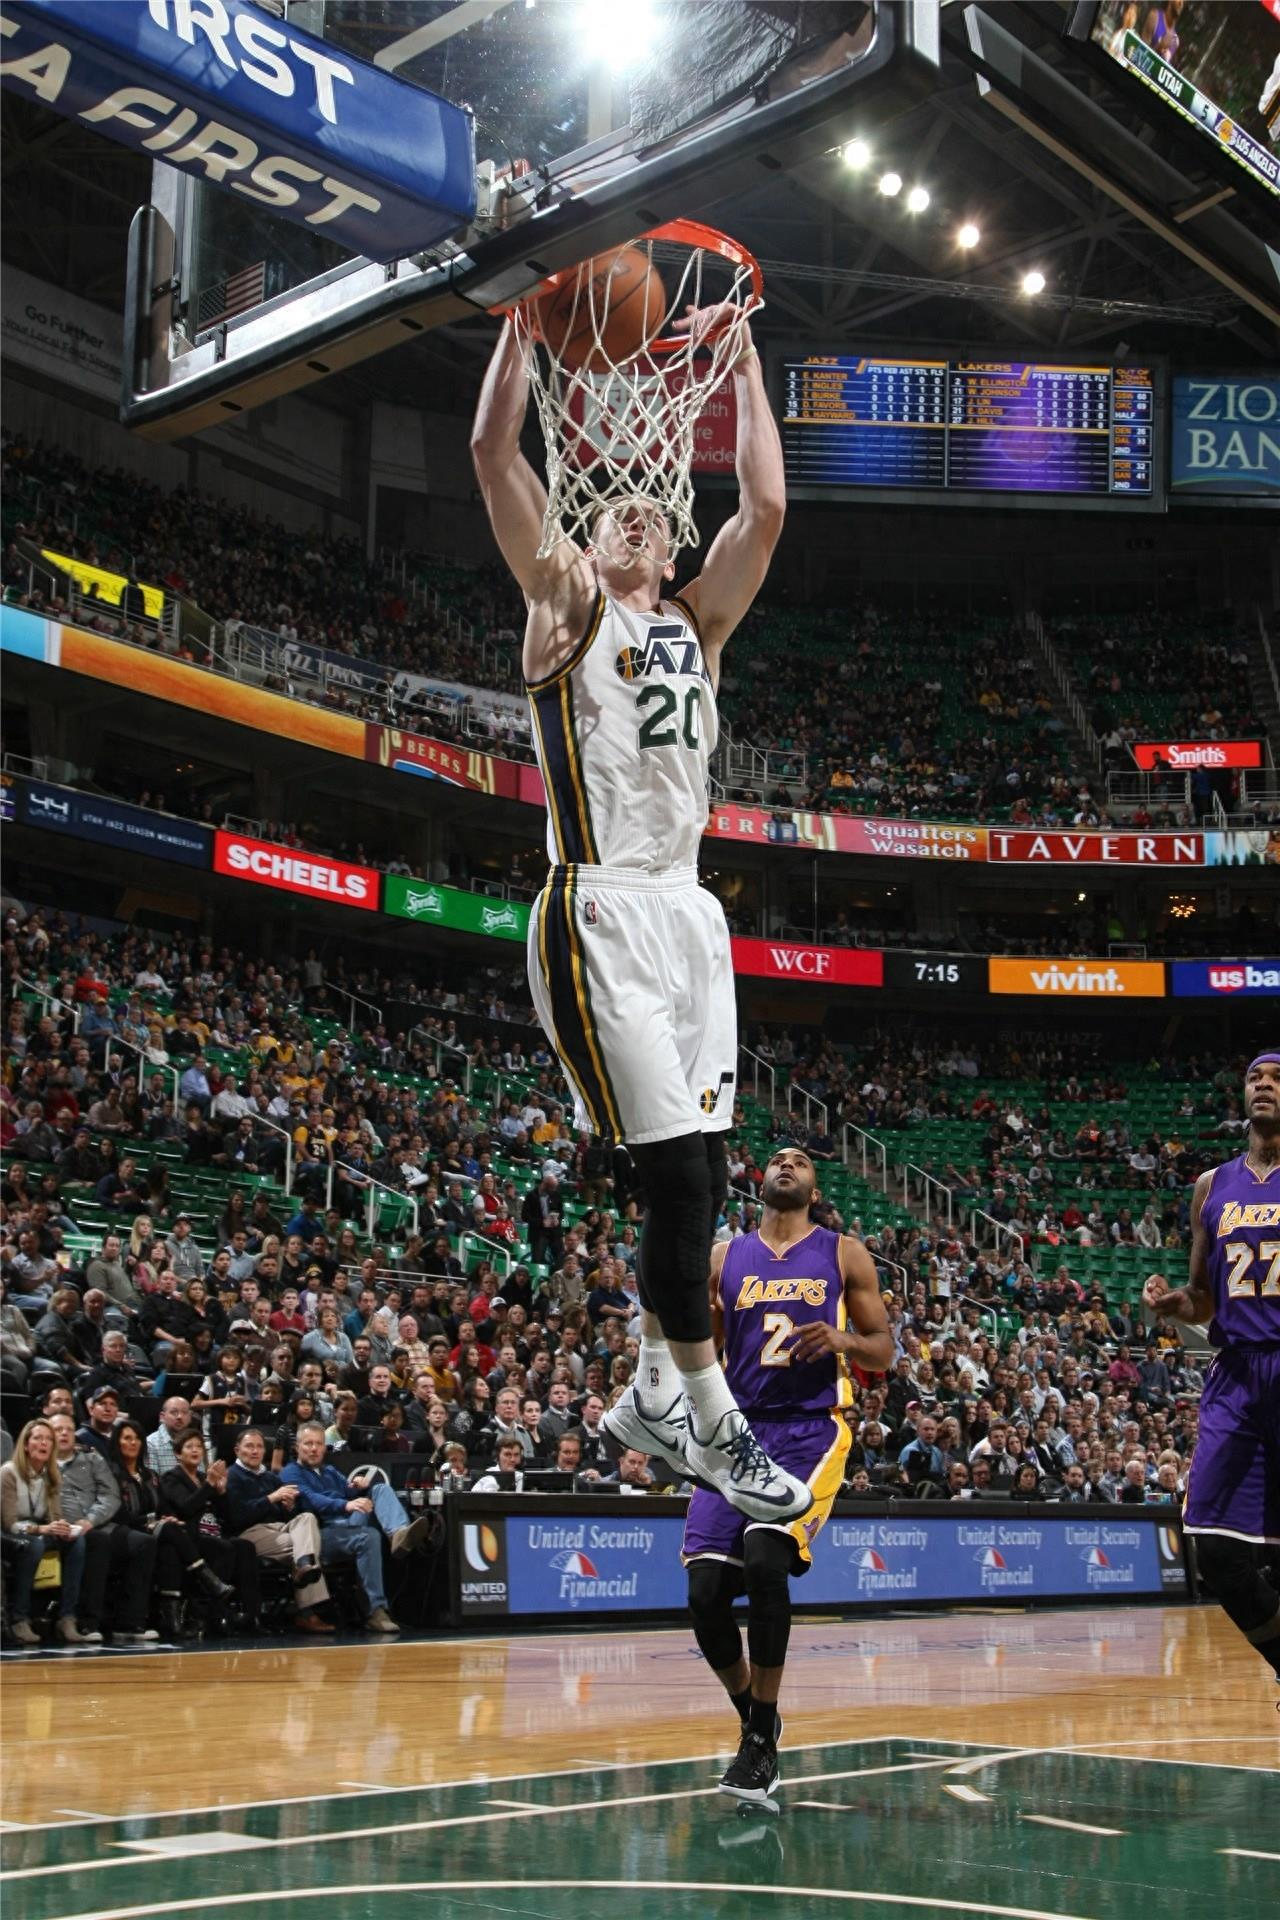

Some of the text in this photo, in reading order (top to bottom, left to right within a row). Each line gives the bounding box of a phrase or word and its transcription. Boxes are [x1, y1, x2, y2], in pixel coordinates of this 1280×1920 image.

[1157, 65, 1184, 98] UTAH
[1201, 104, 1210, 121] 5
[1248, 146, 1279, 180] ANGELES
[78, 87, 381, 225] FIRST
[25, 304, 47, 325] Go
[959, 363, 1012, 372] LAKERS
[1187, 382, 1280, 422] ZIO
[406, 739, 462, 774] BEERS
[1167, 744, 1227, 765] Smith's
[30, 793, 69, 815] 44
[863, 820, 978, 842] Squatters
[869, 838, 970, 859] Wasatch
[993, 834, 1196, 861] TAVERN
[226, 843, 370, 899] SCHEELS
[769, 948, 831, 975] WCF
[914, 962, 960, 982] 7:15
[1225, 1241, 1280, 1297] 27
[735, 1276, 828, 1310] LAKERS
[761, 1313, 794, 1367] 2
[528, 1525, 654, 1554] United Security
[832, 1525, 928, 1551] United Security
[957, 1526, 1042, 1549] United Security
[1065, 1527, 1140, 1549] United Security
[559, 1572, 638, 1598] Financial
[857, 1567, 917, 1589] Financial
[981, 1565, 1033, 1586] Financial
[1087, 1564, 1134, 1583] Financial
[461, 1582, 506, 1594] UNITED
